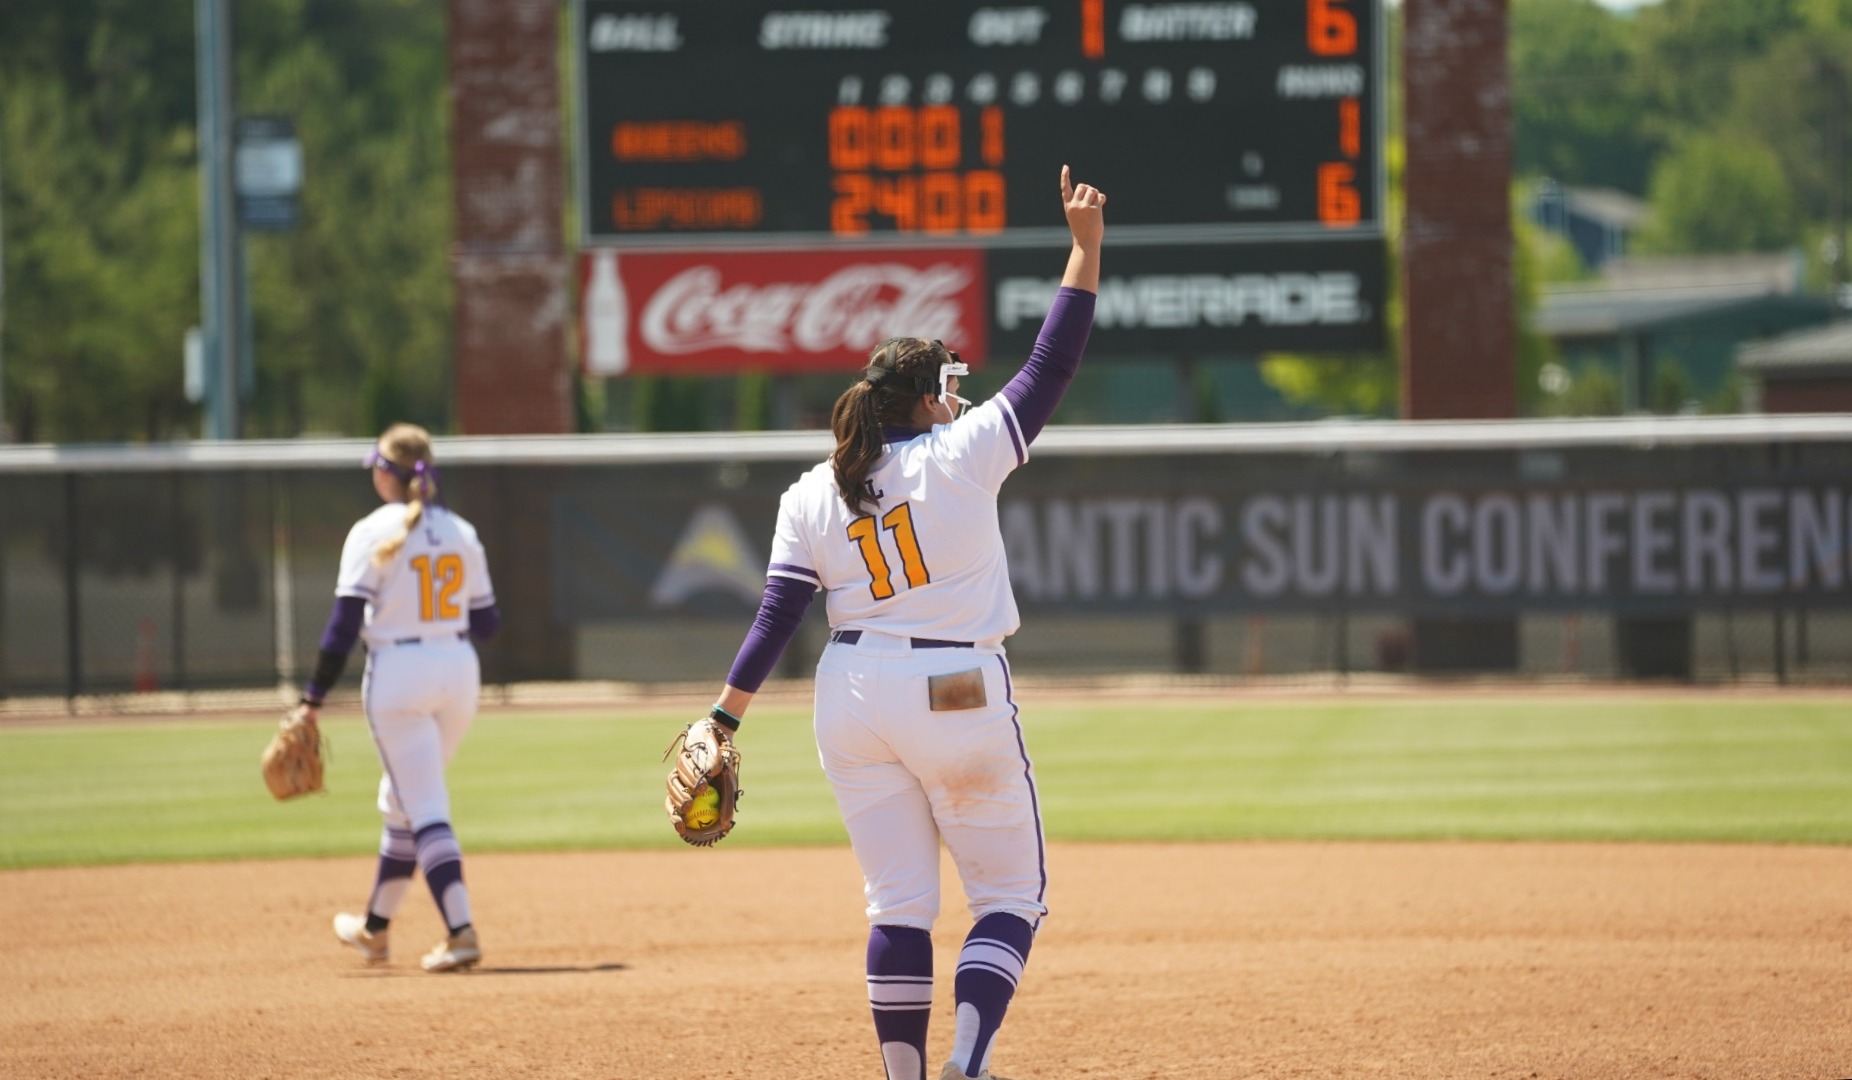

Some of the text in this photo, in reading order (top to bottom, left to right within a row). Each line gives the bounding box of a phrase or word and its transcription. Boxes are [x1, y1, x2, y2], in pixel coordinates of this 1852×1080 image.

[590, 13, 682, 52] BALL
[759, 10, 891, 50] STRIKE
[967, 7, 1048, 45] OUT
[1080, 0, 1105, 58] 1
[1118, 3, 1258, 42] BATTER
[1307, 0, 1358, 56] 6
[1338, 98, 1361, 158] 1
[1316, 161, 1361, 229] 6
[996, 271, 1362, 330] PWERADE
[846, 501, 931, 600] 11
[1242, 497, 1397, 597] SUN
[1420, 490, 1852, 598] CONFEREN
[410, 553, 465, 622] 12
